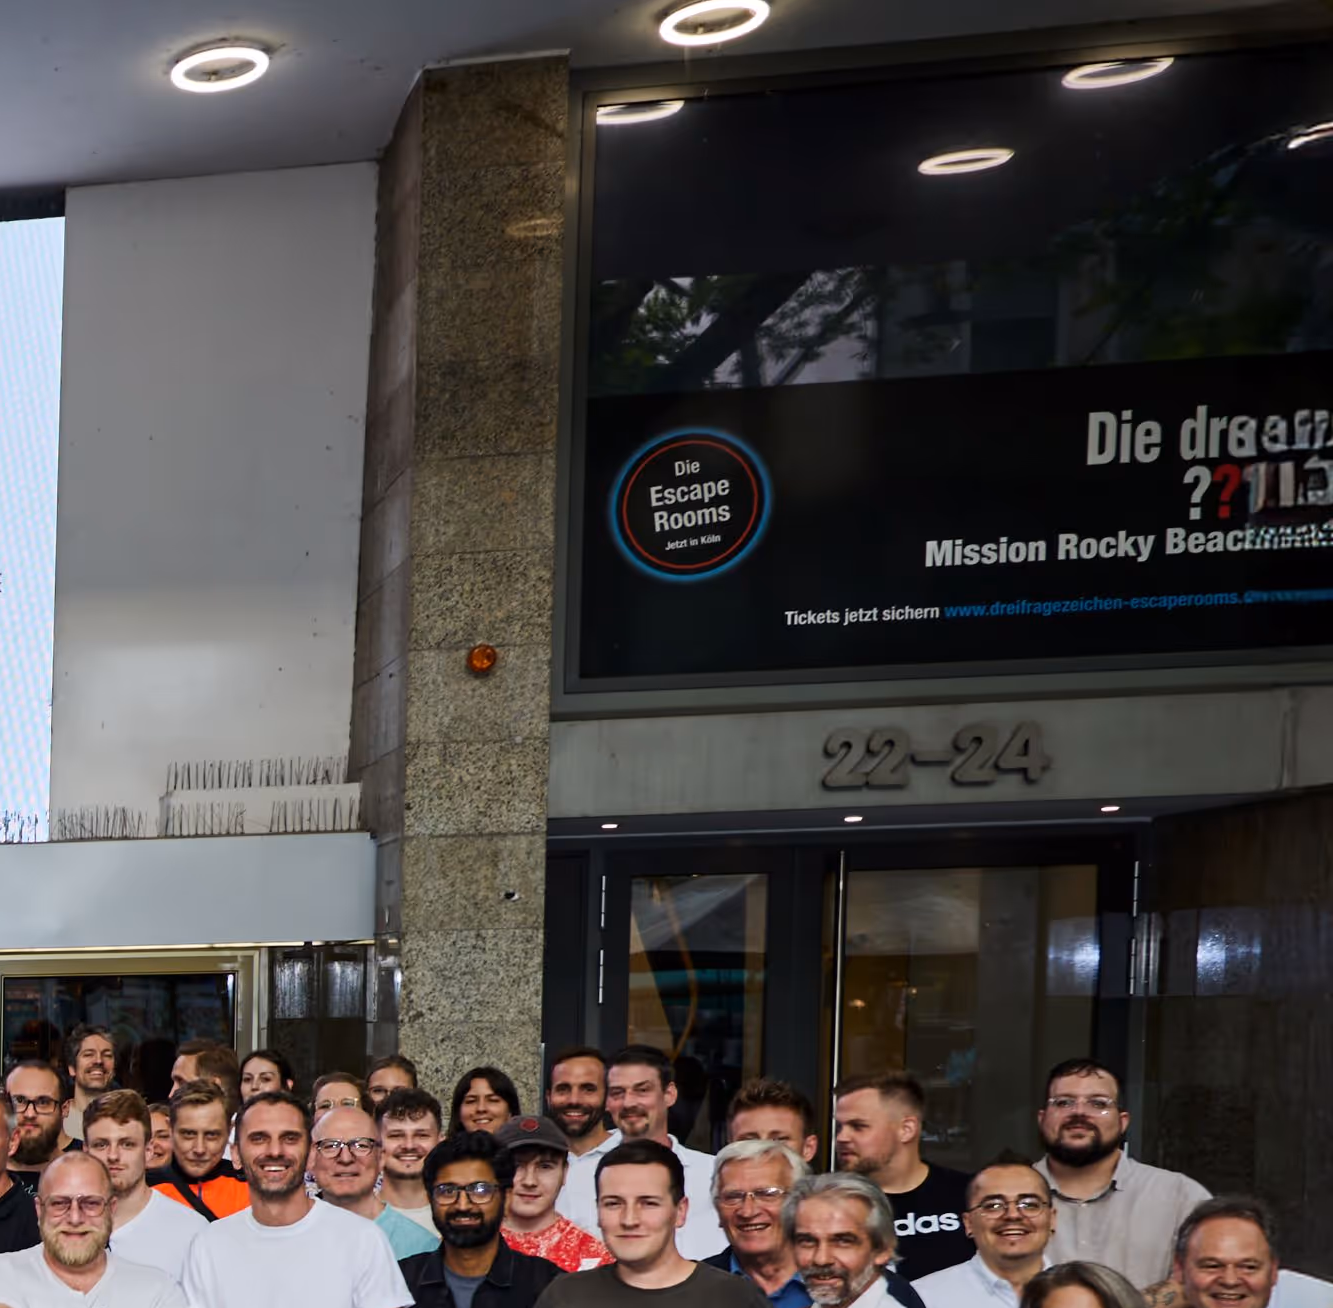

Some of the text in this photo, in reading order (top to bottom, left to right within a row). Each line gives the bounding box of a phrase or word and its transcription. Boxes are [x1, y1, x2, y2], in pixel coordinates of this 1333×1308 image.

[1087, 409, 1162, 465] Die
[674, 459, 701, 477] Die
[649, 478, 730, 507] Escape
[653, 505, 731, 533] Rooms
[665, 534, 721, 551] Jetzt in Köln
[925, 537, 1047, 568] Mission
[1057, 530, 1157, 562] Rocky
[785, 589, 1268, 627] Tickets jetzt sichern www.dreifragezeichen-escaperooms.
[822, 720, 1053, 791] 22-24
[893, 1212, 961, 1237] das
